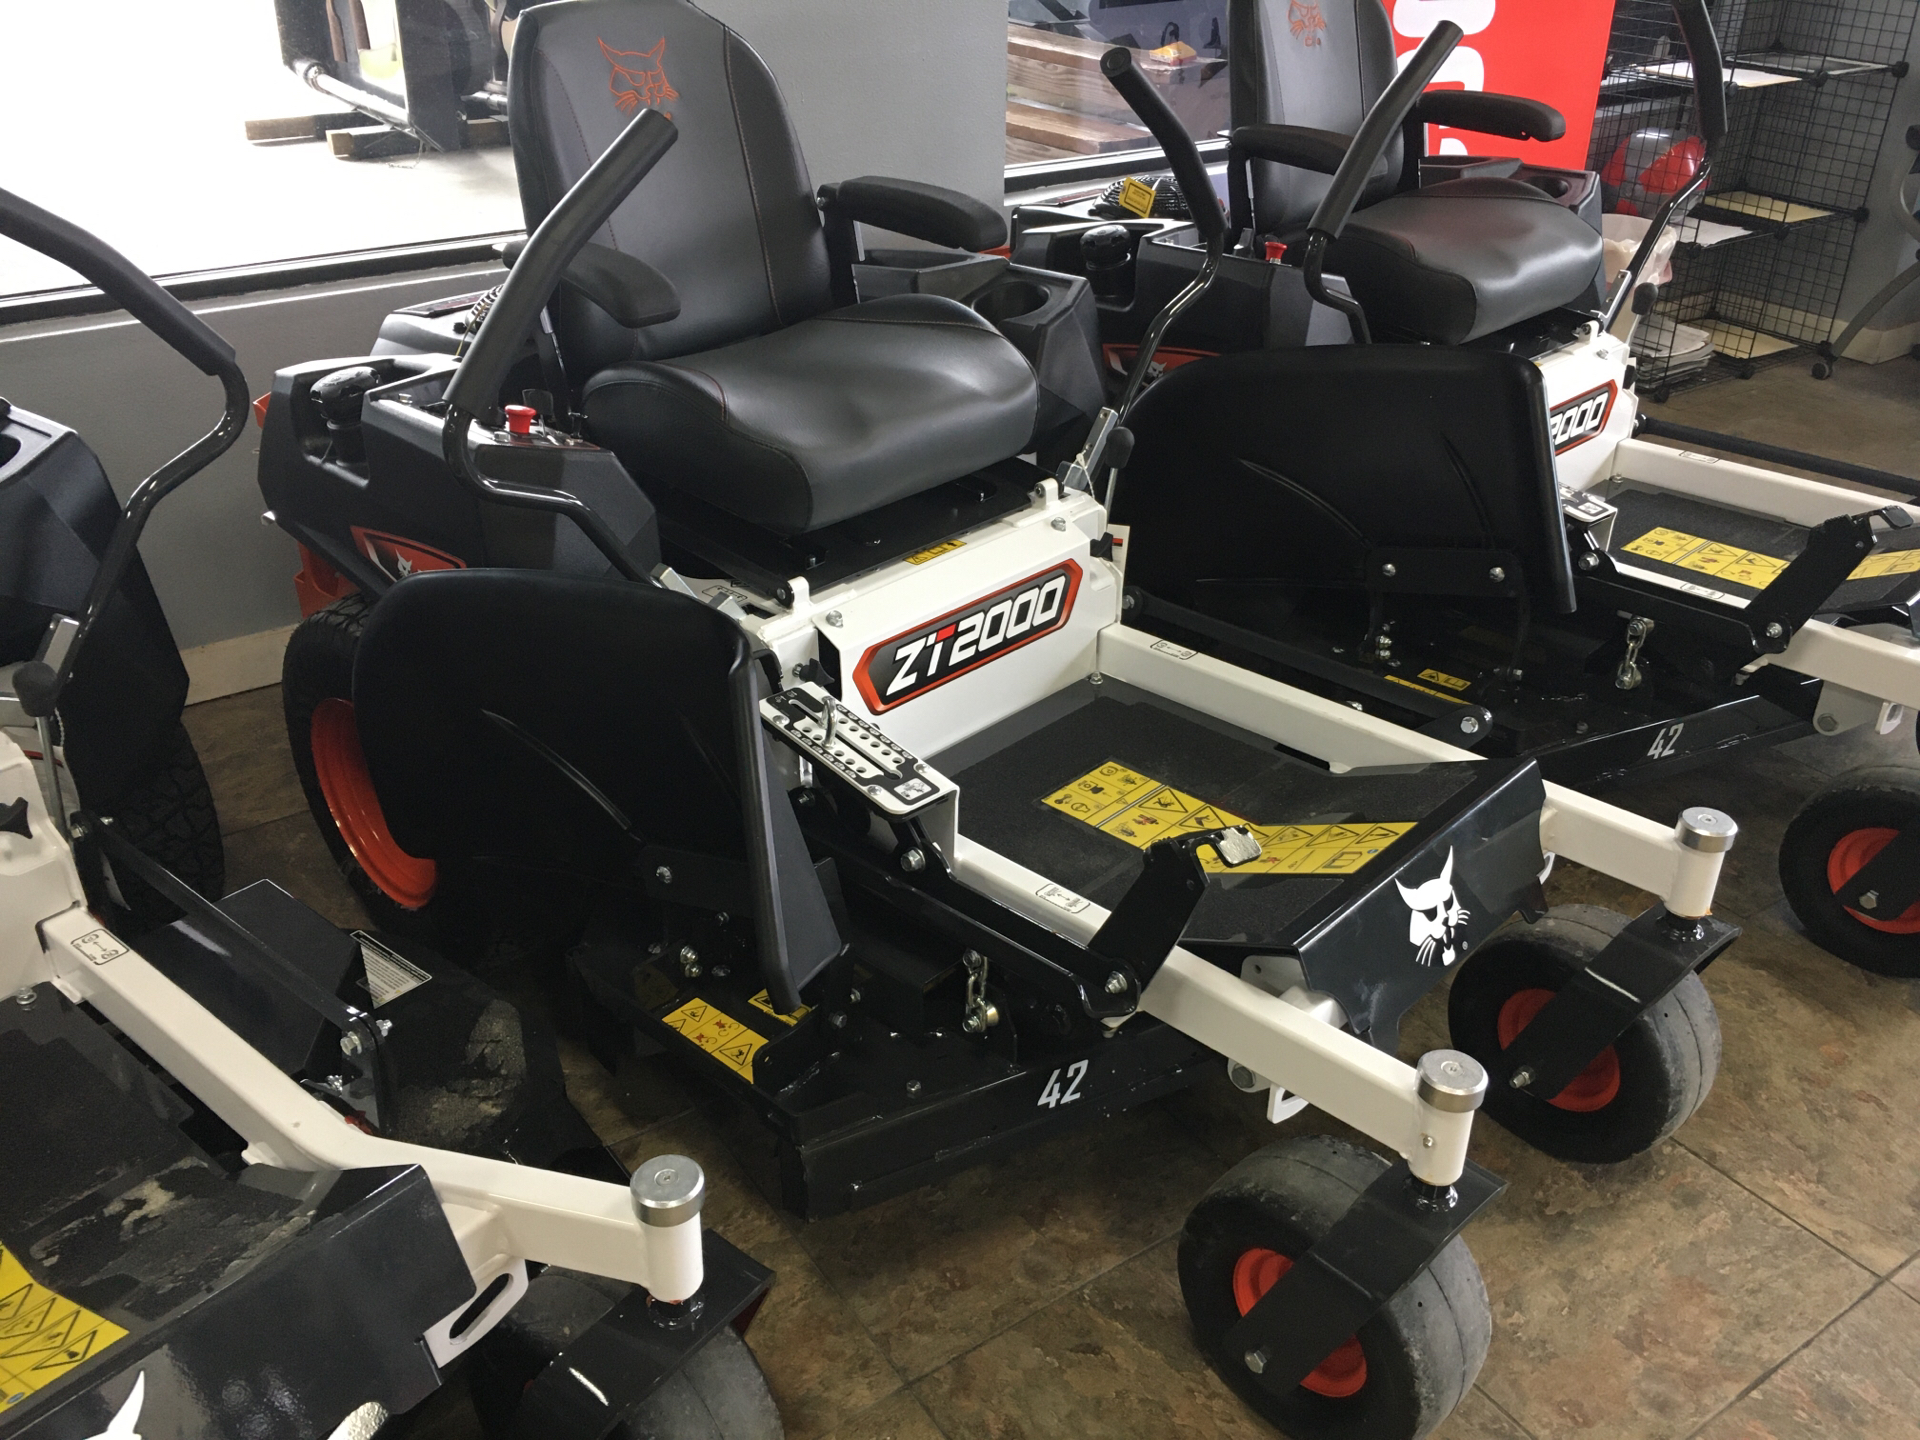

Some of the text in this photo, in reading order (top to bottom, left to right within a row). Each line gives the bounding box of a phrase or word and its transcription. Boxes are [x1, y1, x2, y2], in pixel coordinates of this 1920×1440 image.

[886, 575, 1066, 697] ZT2000
[1646, 722, 1685, 760] 42
[1037, 1059, 1089, 1109] 42
